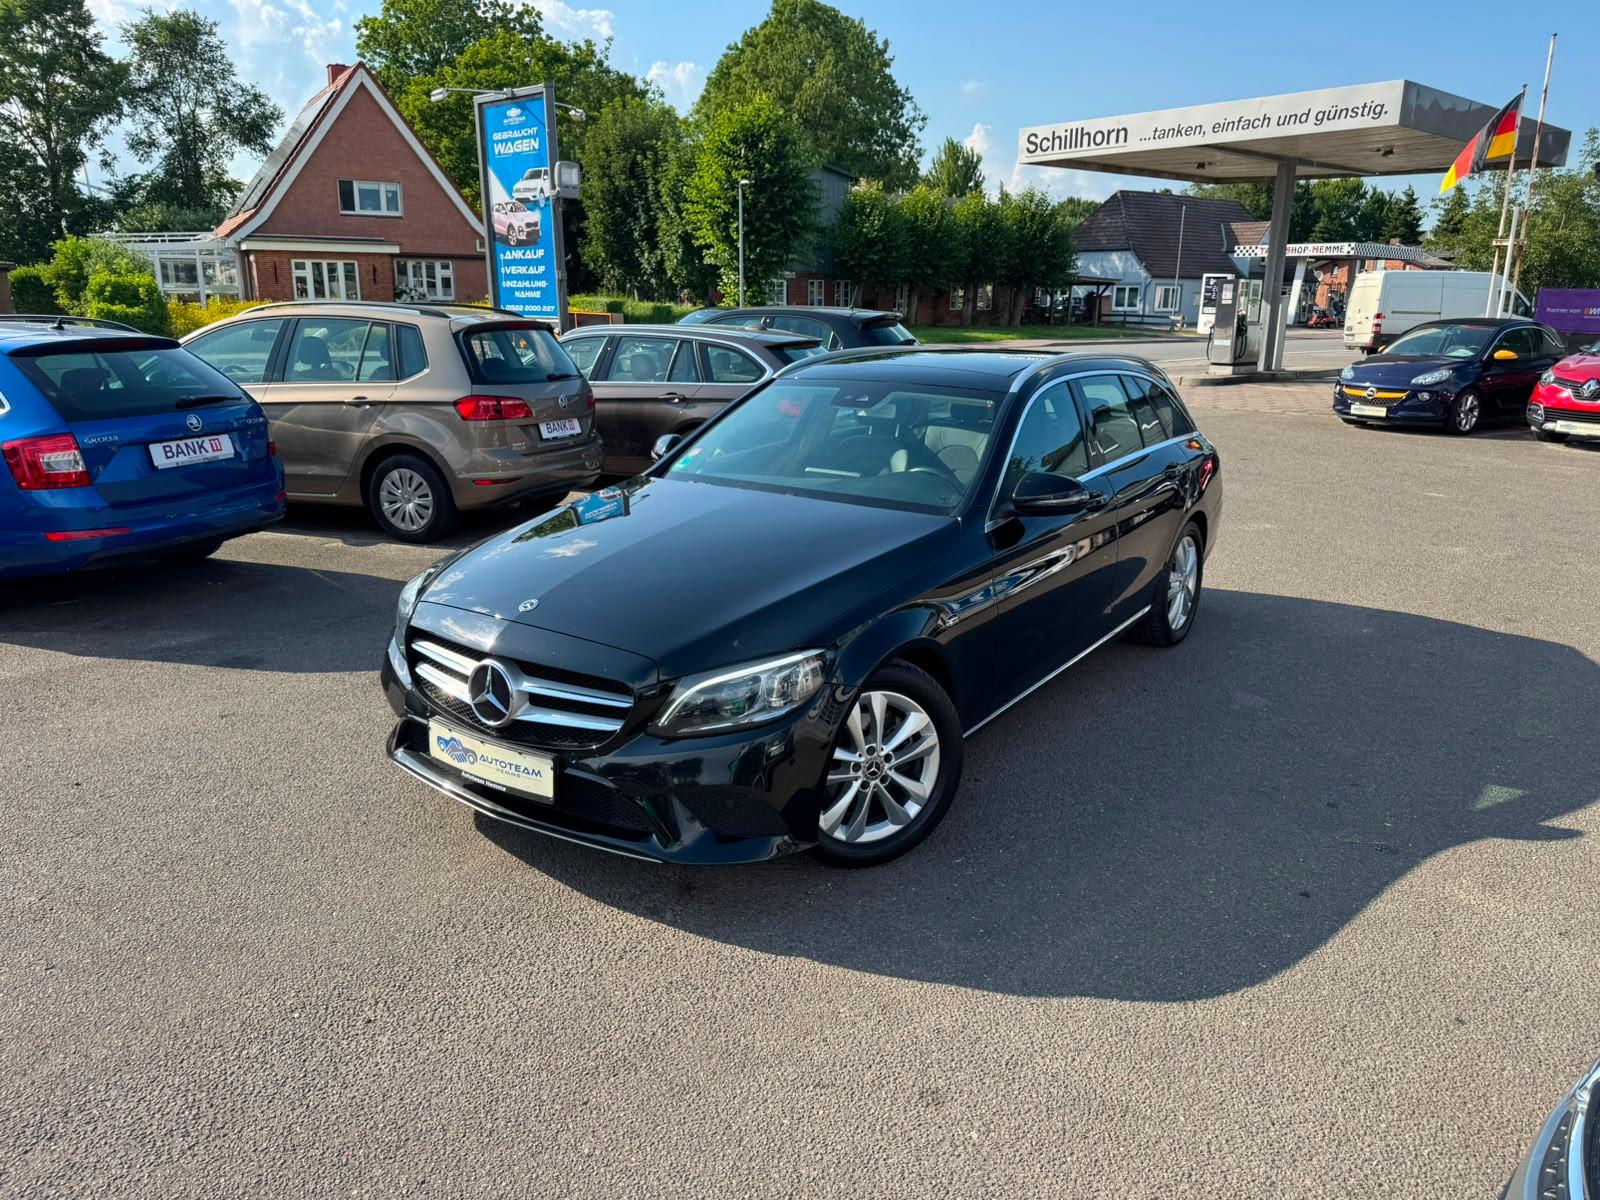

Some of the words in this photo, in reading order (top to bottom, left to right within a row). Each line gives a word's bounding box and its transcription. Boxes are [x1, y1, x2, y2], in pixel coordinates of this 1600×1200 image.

[492, 126, 538, 141] GEBRAUCHT
[1026, 127, 1128, 154] Schillhorn
[1211, 113, 1271, 134] einfach
[1276, 108, 1312, 127] und
[1313, 100, 1389, 126] günstig.
[493, 137, 539, 155] WAGEN
[504, 249, 545, 260] ANKAUF
[505, 266, 546, 275] VERKAUF
[515, 290, 542, 298] NAHME
[546, 421, 569, 434] BANK
[162, 440, 209, 460] BANK
[479, 754, 542, 778] AUTOTEAM
